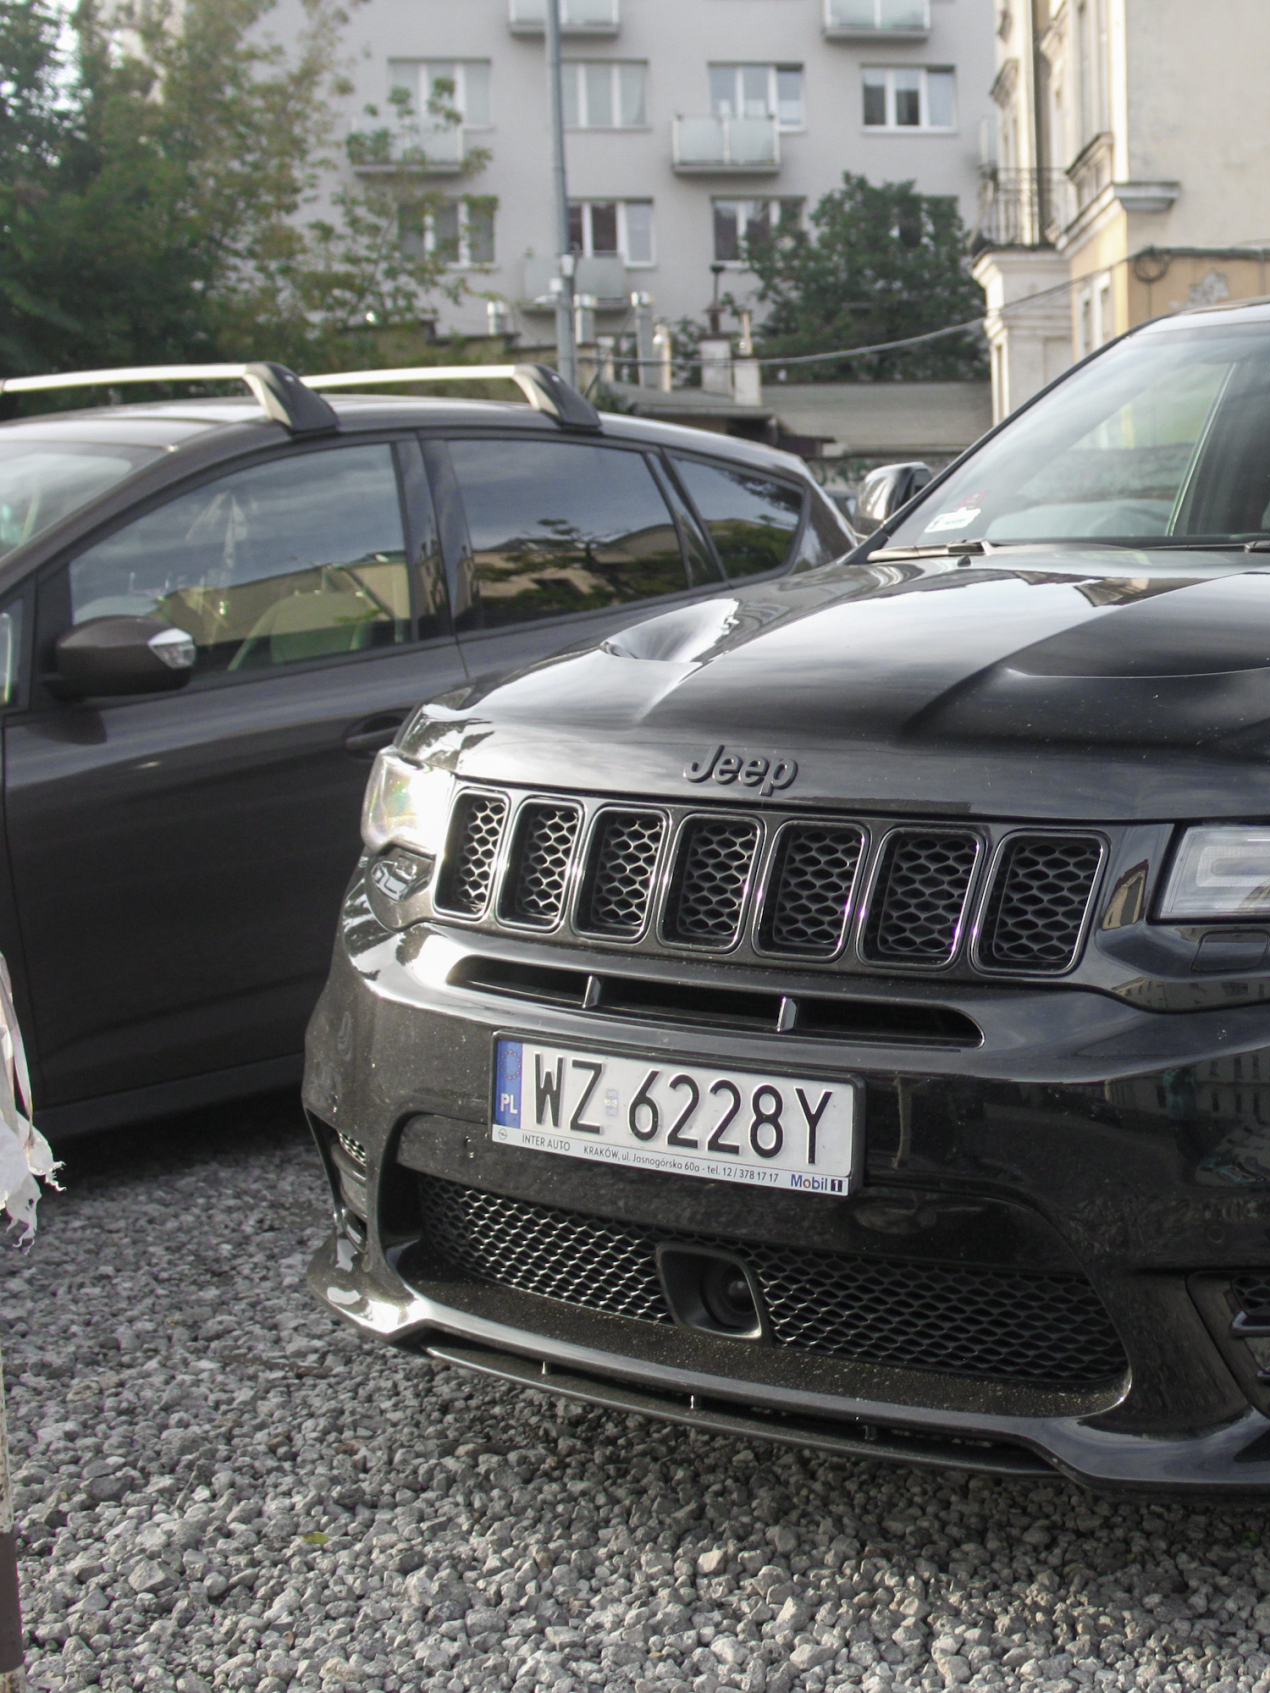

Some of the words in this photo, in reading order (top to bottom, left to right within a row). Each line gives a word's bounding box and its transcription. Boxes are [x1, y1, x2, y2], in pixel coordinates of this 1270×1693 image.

[683, 744, 799, 797] Jeep
[500, 1092, 518, 1115] PL
[534, 1053, 604, 1135] WZ
[628, 1069, 833, 1165] 6228Y
[522, 1133, 545, 1148] INTER
[547, 1138, 571, 1152] AUTO
[583, 1144, 621, 1161] KRAKÓW,
[621, 1152, 631, 1162] ul.
[632, 1153, 683, 1169] Jasnogórska
[684, 1160, 699, 1172] 60a
[707, 1164, 721, 1176] tel.
[722, 1166, 733, 1177] 12
[739, 1168, 755, 1180] 378
[757, 1170, 767, 1181] 17
[769, 1172, 780, 1183] 17
[790, 1173, 828, 1191] Mobil
